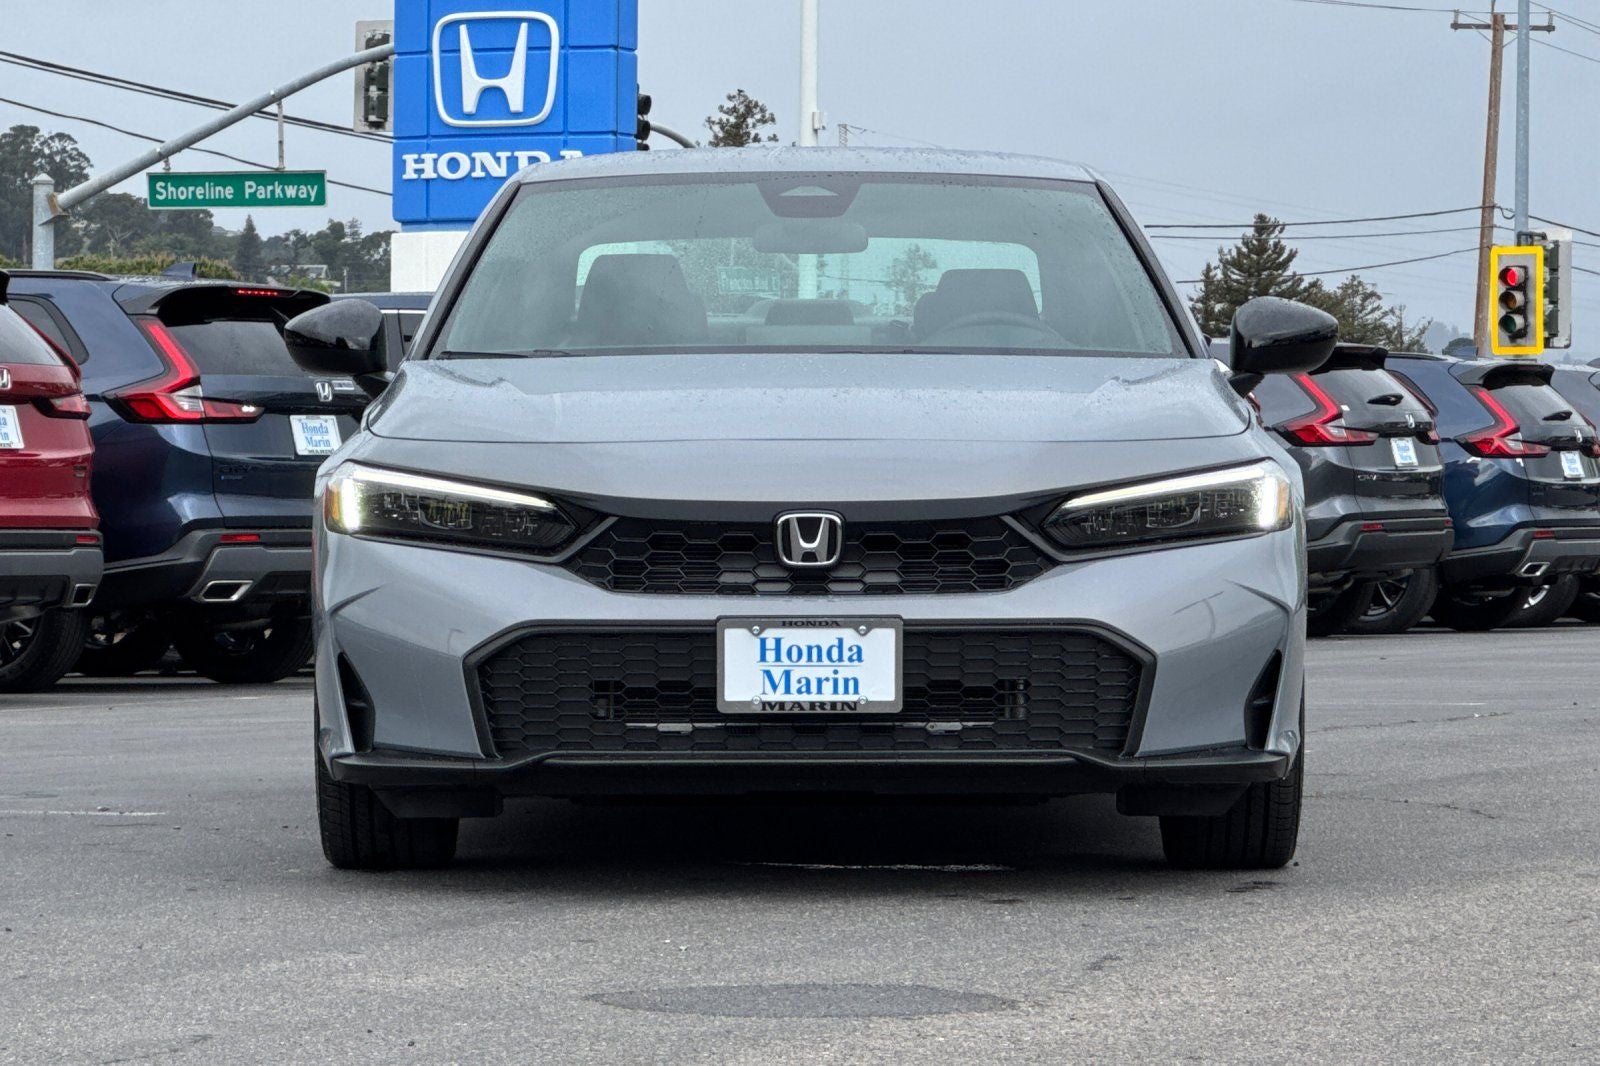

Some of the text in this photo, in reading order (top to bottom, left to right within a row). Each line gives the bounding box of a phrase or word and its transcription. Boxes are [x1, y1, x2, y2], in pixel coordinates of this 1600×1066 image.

[155, 181, 318, 202] Shoreline Parkway
[301, 422, 329, 434] Honda
[757, 637, 864, 663] Honda
[760, 669, 860, 695] Marin
[761, 701, 858, 711] MARIN
